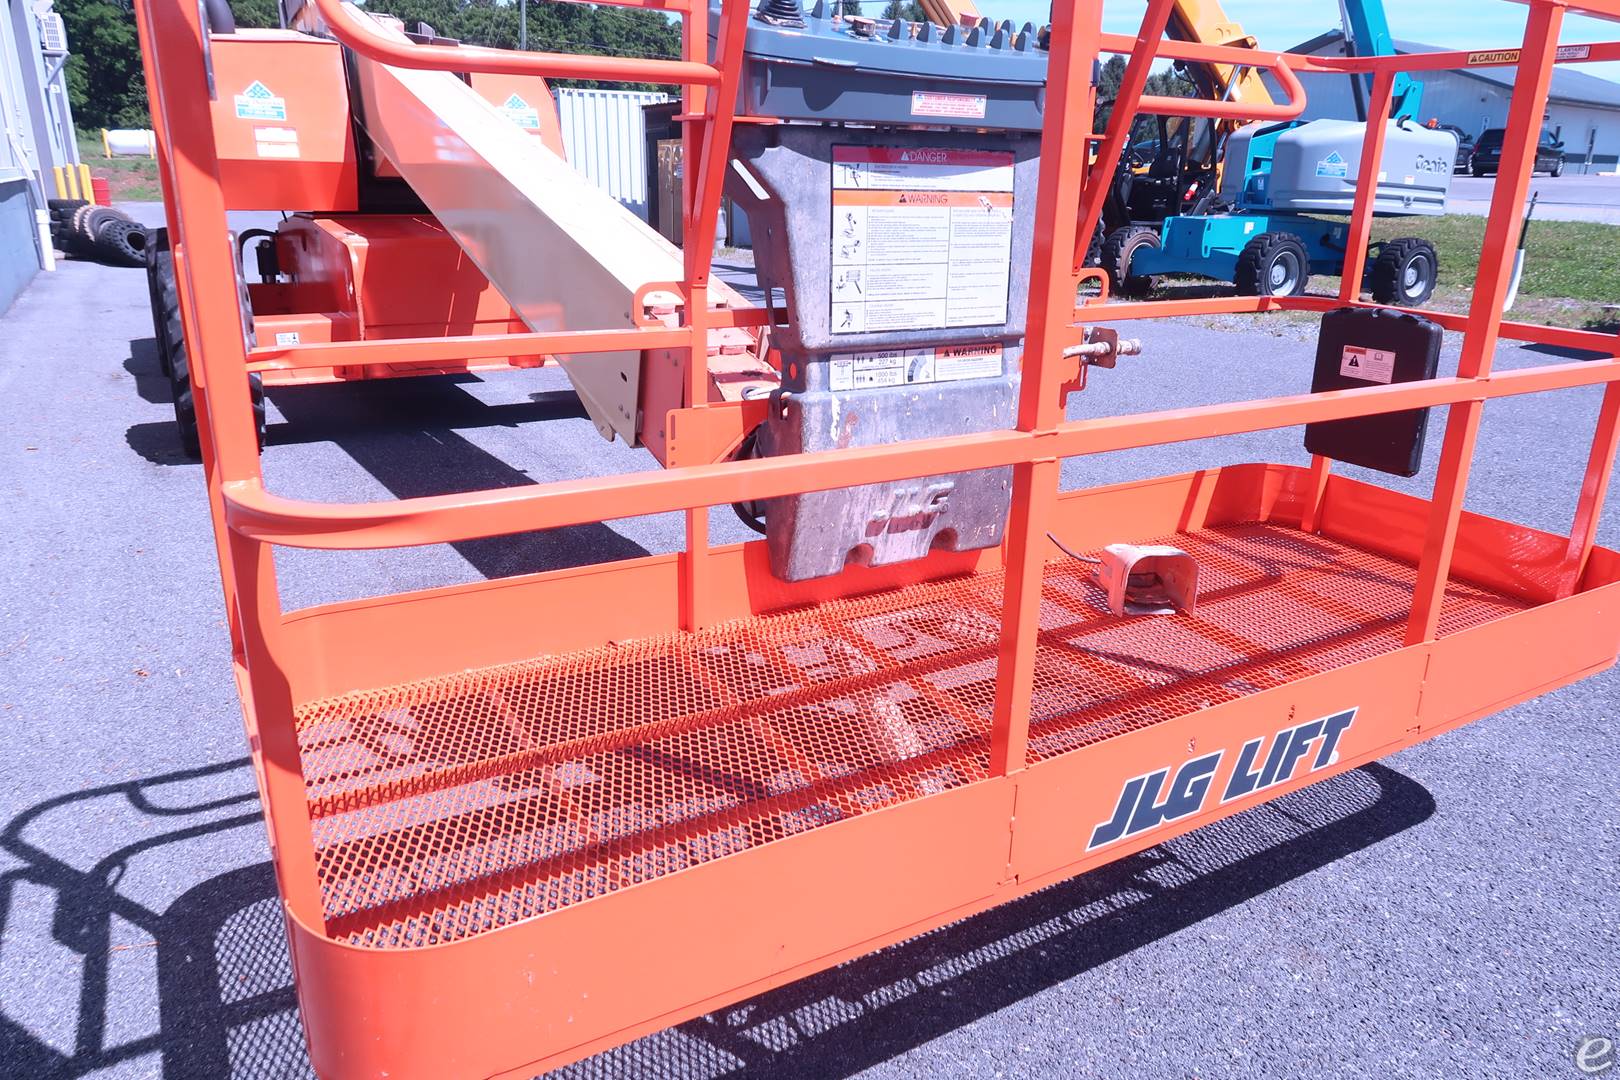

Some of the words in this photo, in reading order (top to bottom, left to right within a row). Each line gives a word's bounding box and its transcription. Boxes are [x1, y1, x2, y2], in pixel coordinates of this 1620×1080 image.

[1478, 52, 1518, 62] CAUTION
[910, 152, 947, 162] DANGER
[1416, 155, 1447, 173] Genie
[908, 194, 948, 204] WARNING
[953, 346, 997, 357] WARNING
[1085, 748, 1226, 852] JLG
[1220, 706, 1359, 803] LIFT
